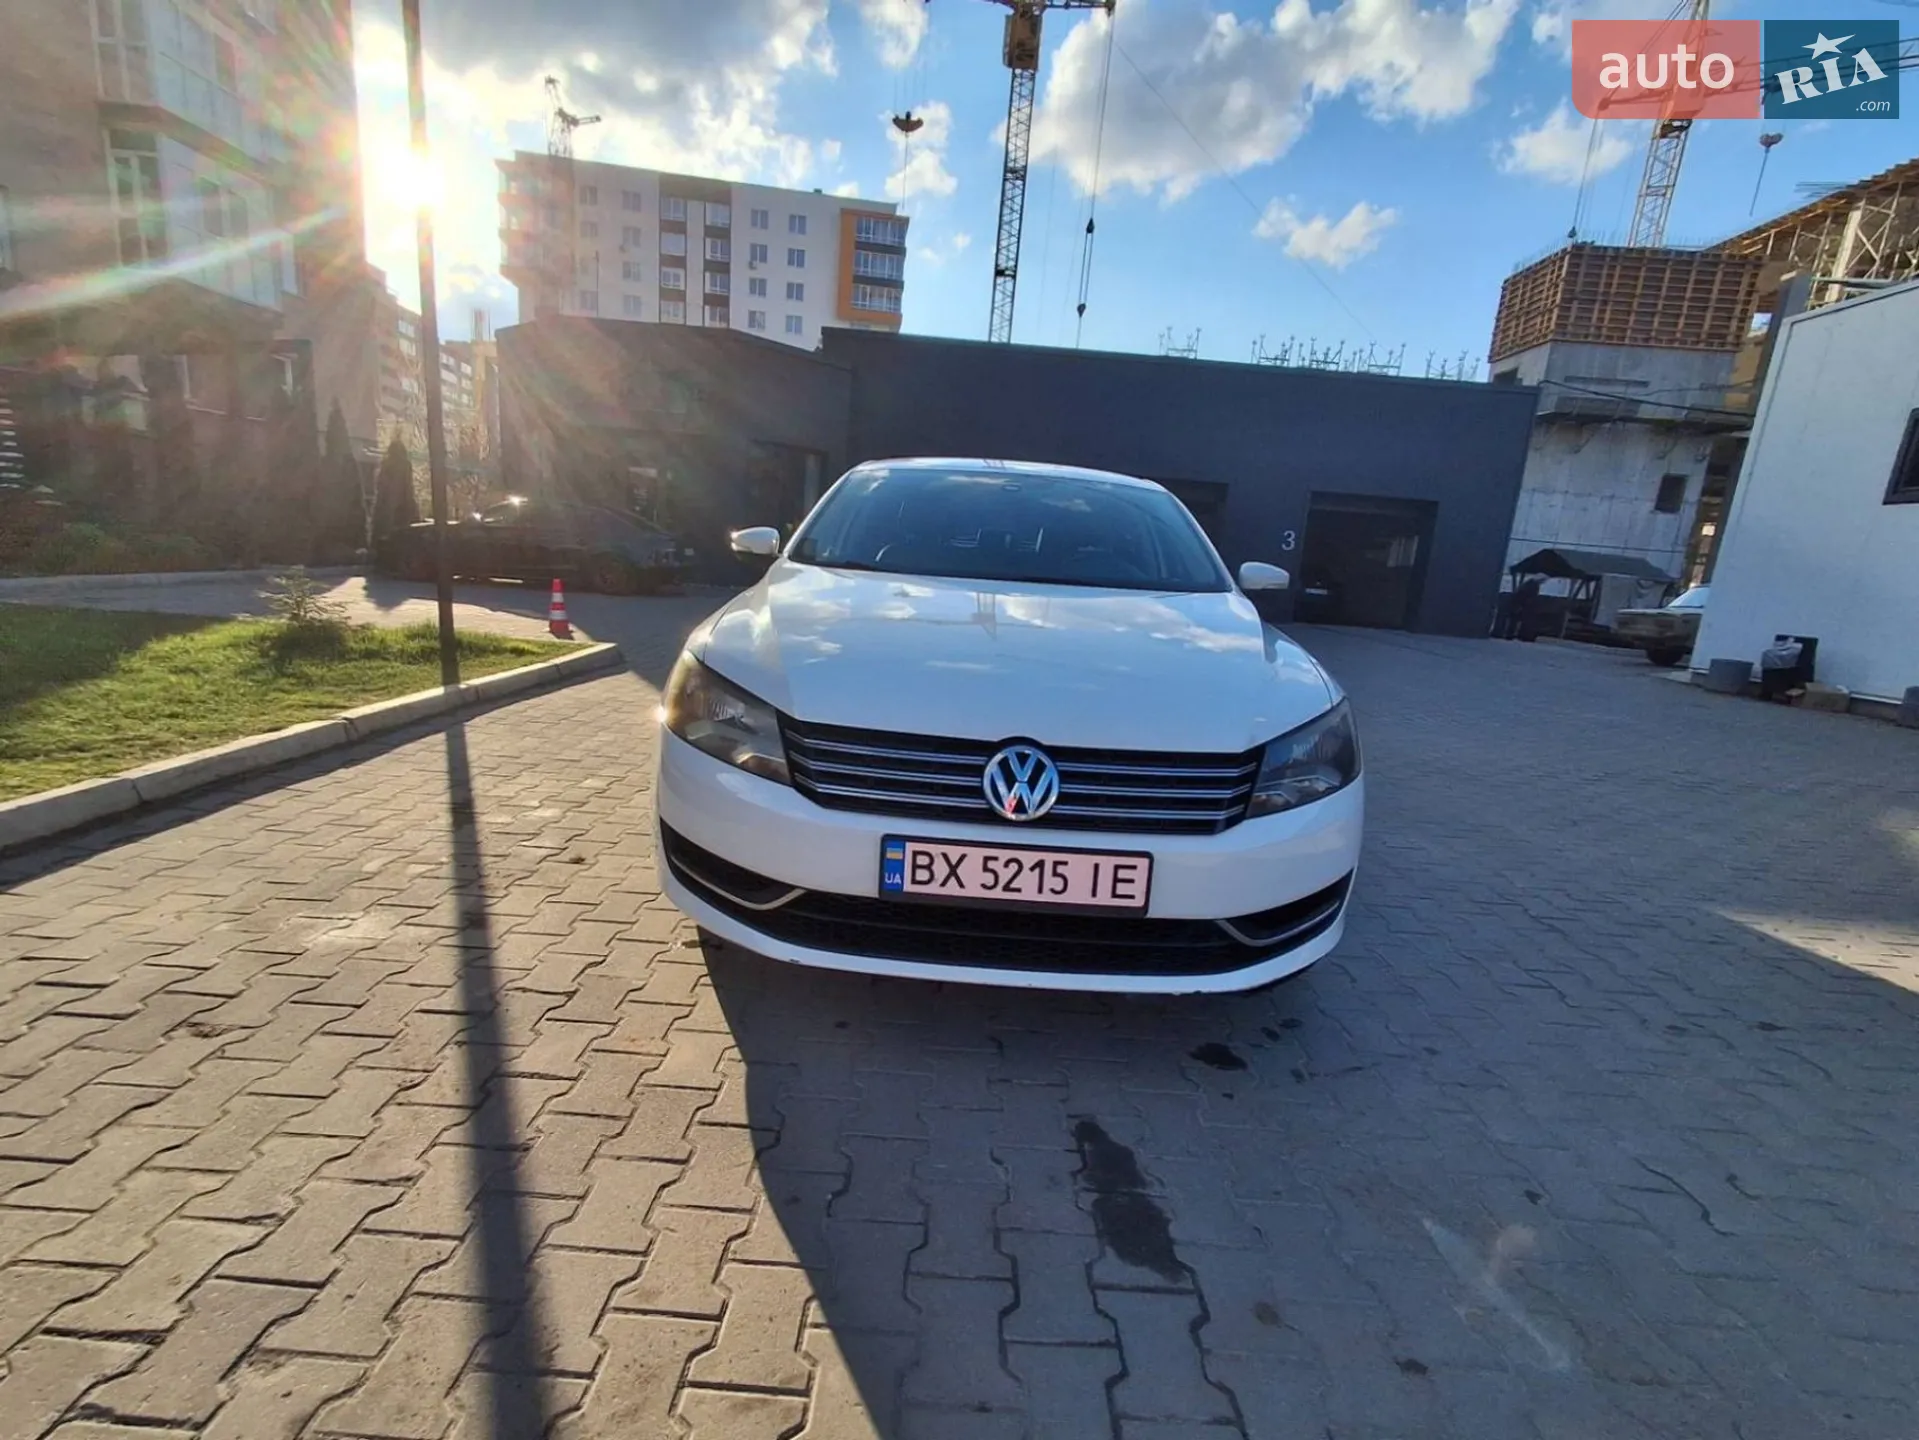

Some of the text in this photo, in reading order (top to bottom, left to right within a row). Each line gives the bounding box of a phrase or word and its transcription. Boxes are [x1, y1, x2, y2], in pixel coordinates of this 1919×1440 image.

[1281, 530, 1296, 551] 3
[885, 872, 902, 885] UA
[910, 850, 1139, 900] BX 5215 IE
